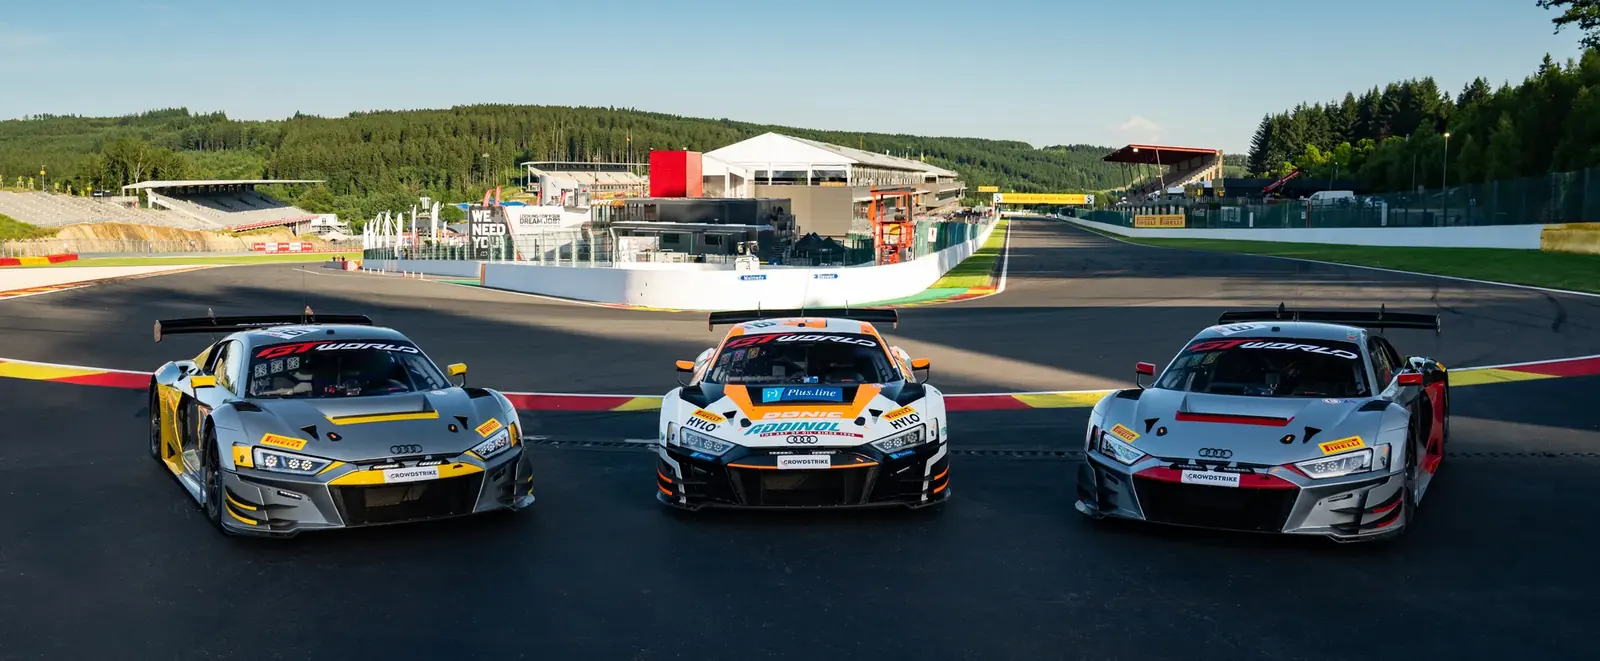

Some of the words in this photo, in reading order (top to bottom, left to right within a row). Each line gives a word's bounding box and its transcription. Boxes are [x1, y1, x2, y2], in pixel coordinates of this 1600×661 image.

[471, 210, 491, 222] WE
[1160, 217, 1183, 226] PIRELLI
[471, 223, 506, 236] NEED
[776, 335, 877, 347] WORLD
[315, 343, 419, 354] WORLD
[1239, 341, 1358, 360] WORLD
[787, 388, 837, 398] Plus.line
[695, 410, 722, 422] PIRELLI
[762, 411, 844, 420] DONIC
[885, 406, 912, 419] PIRELLI
[478, 420, 500, 436] PIRELLI
[686, 416, 716, 432] HYLO
[889, 413, 920, 430] HYLO
[744, 421, 841, 436] ADDINOL
[1112, 425, 1136, 441] PIRELLI
[264, 435, 303, 448] PIRELLI
[1322, 438, 1361, 452] PIRELLI
[390, 470, 437, 480] CROWDSTRIKE
[1188, 473, 1238, 483] CROWDSTRIKE
